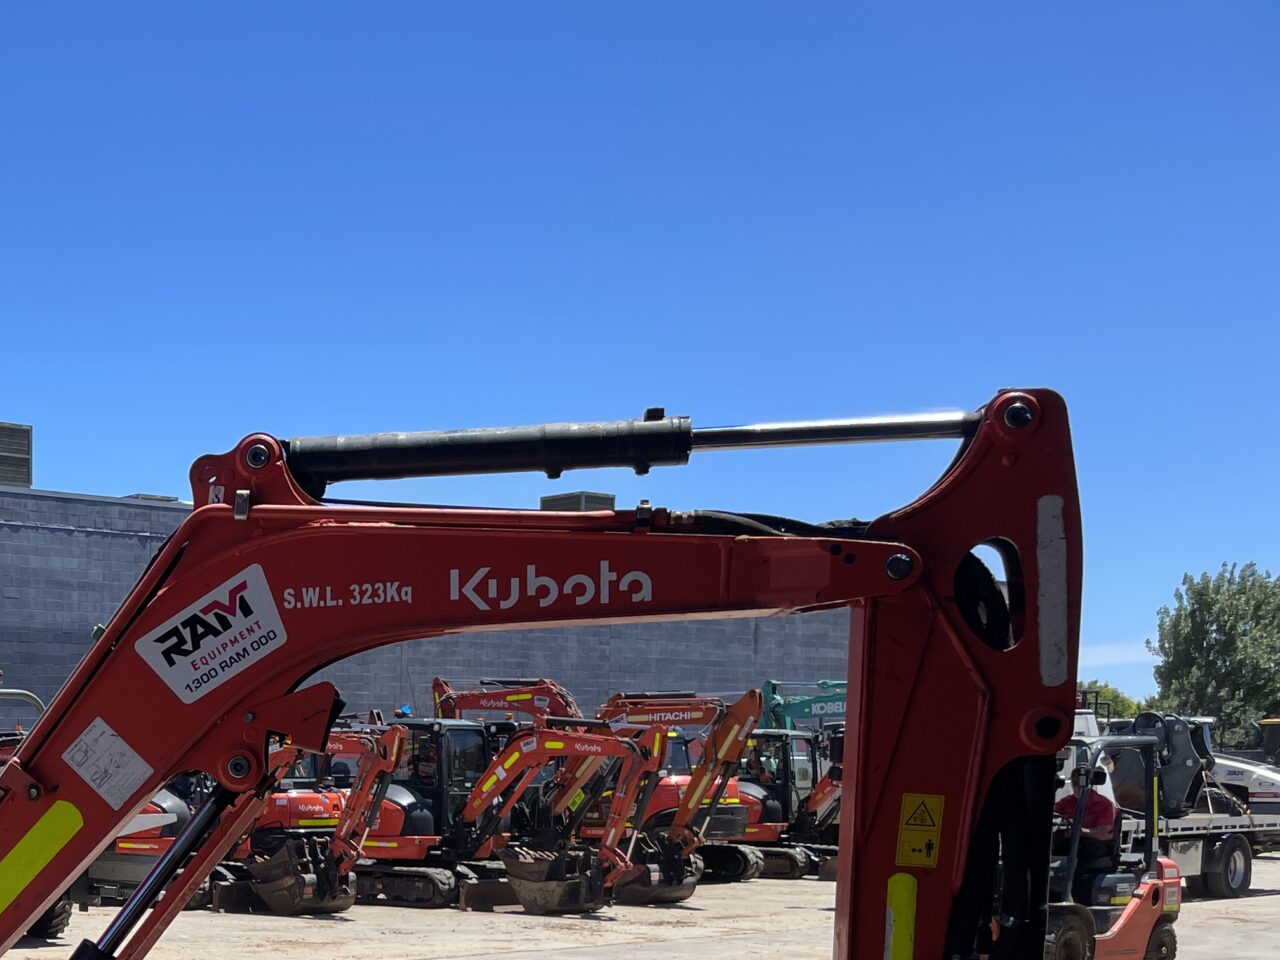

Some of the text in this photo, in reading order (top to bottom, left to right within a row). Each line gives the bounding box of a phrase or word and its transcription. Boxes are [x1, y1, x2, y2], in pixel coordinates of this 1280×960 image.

[283, 586, 343, 609] S.W.L.
[450, 560, 652, 611] Kubota
[153, 580, 254, 667] RAM
[190, 620, 263, 671] EQUIPMENT
[184, 629, 278, 693] 1300 RAM 000
[649, 711, 691, 722] HITACHI
[811, 701, 847, 715] KOBEL
